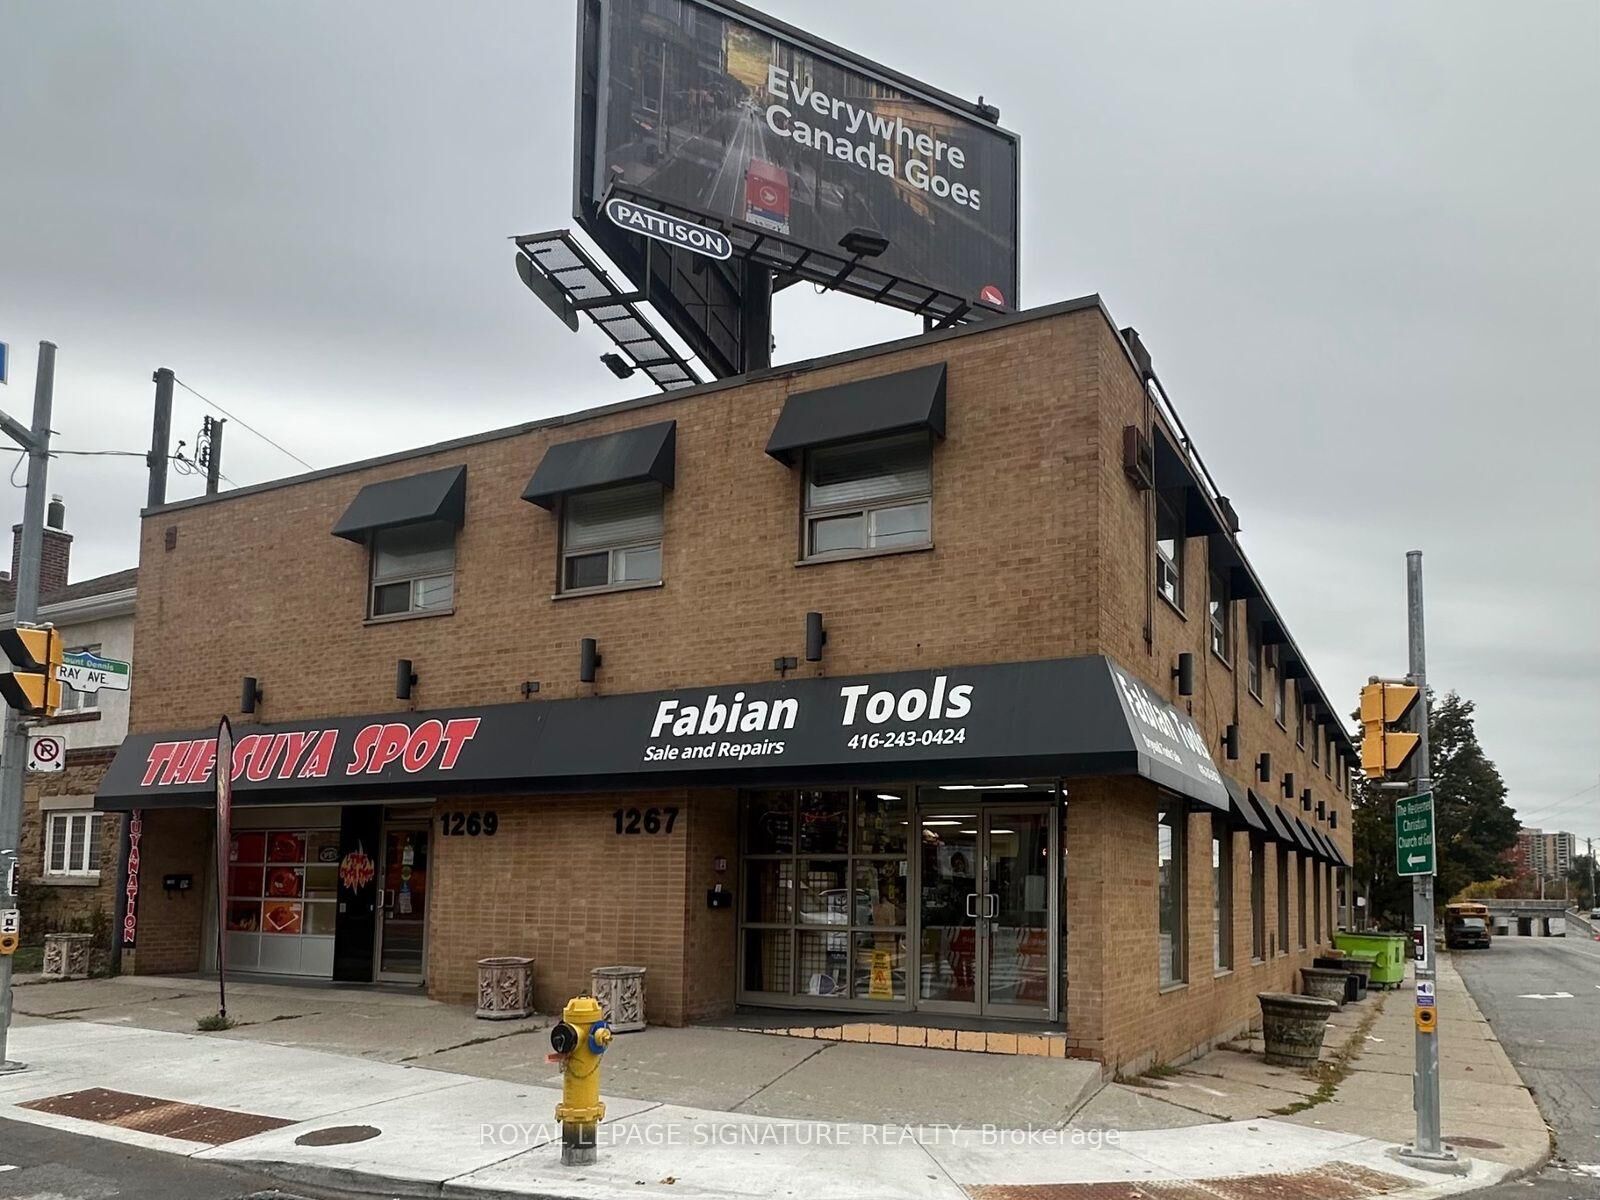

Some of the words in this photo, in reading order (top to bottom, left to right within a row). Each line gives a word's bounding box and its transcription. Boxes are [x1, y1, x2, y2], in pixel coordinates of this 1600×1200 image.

[768, 64, 966, 170] Everywhere
[765, 104, 896, 179] Canada
[904, 158, 982, 211] Goes
[616, 204, 723, 255] PATTISON
[60, 666, 81, 680] RAY
[88, 671, 107, 684] AVE
[64, 657, 84, 666] ount
[87, 660, 114, 671] Dennis
[650, 691, 799, 738] Fabian
[840, 675, 975, 726] Tools
[140, 739, 217, 787] THE
[231, 729, 339, 782] SUYA
[346, 717, 482, 776] SPOT
[643, 745, 679, 762] Sale
[682, 742, 717, 758] and
[719, 739, 785, 761] Repairs
[847, 727, 966, 750] 416-243-0424
[440, 811, 499, 836] 1269
[612, 807, 680, 835] 1267
